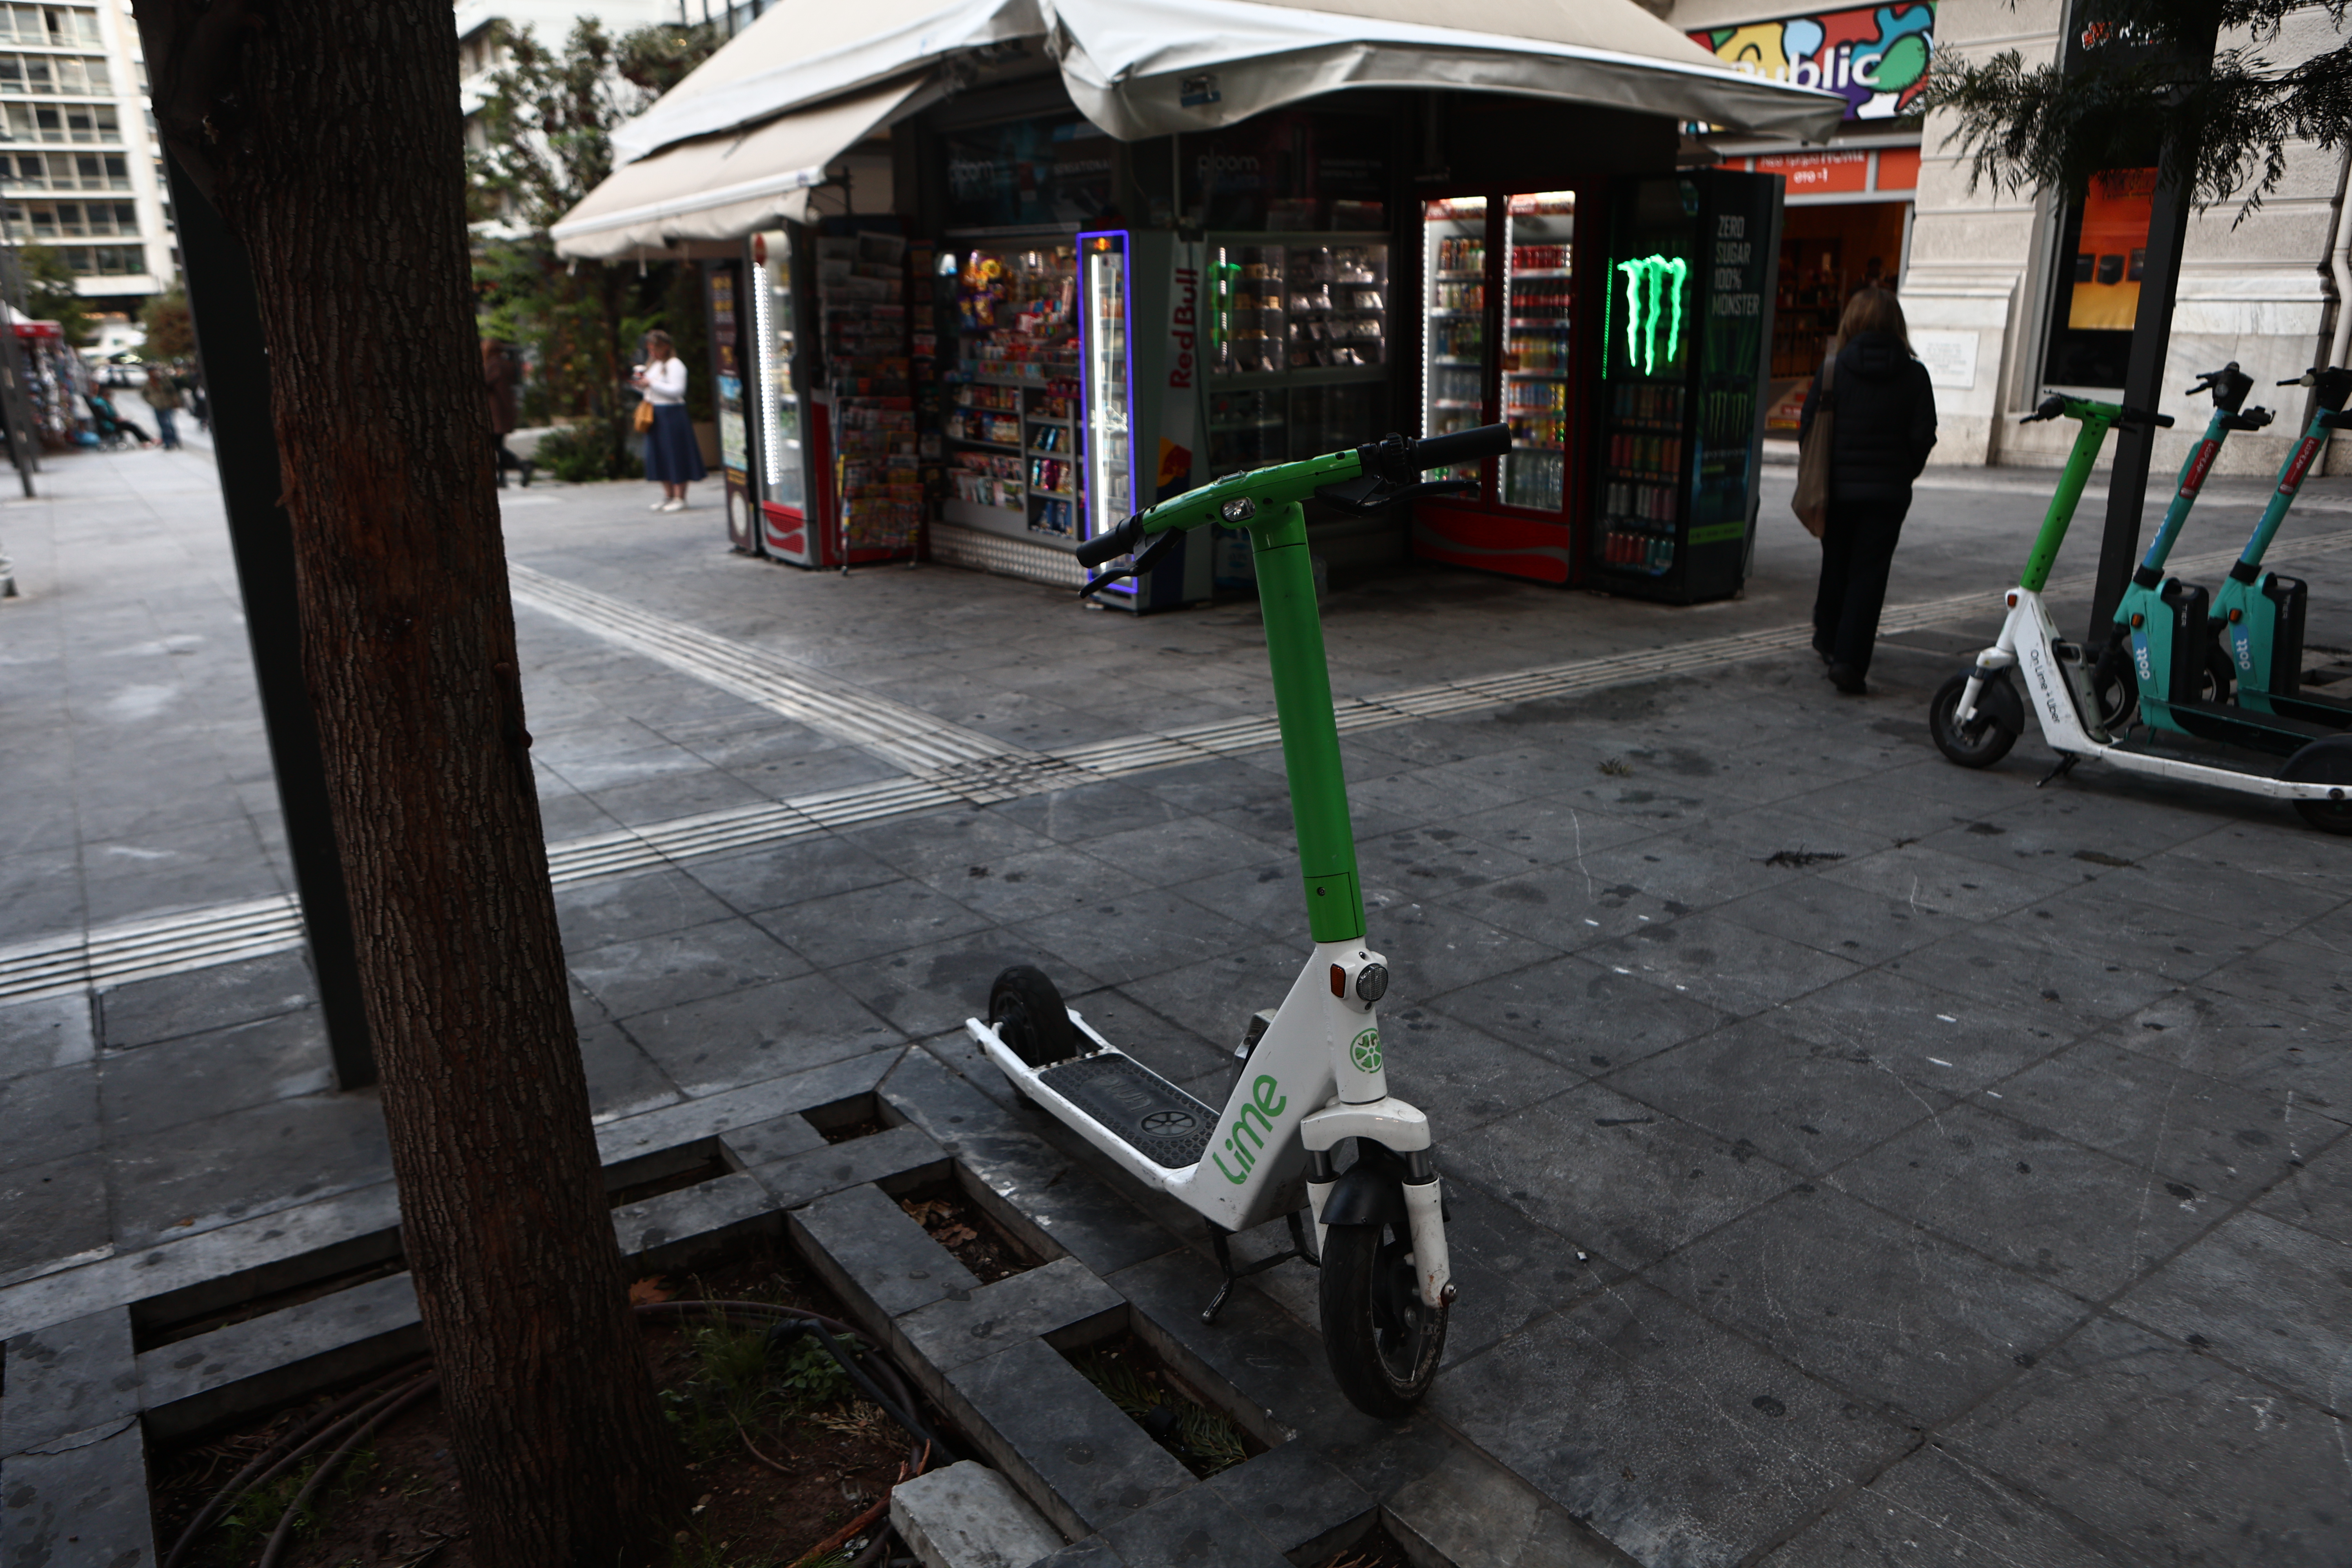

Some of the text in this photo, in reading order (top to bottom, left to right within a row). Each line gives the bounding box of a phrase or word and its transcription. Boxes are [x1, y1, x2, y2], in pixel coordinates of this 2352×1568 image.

[1717, 214, 1744, 240] ZERO
[1715, 241, 1751, 265] SUGAR
[1714, 267, 1742, 292] 100%
[1711, 293, 1760, 317] MONSTER
[1170, 268, 1198, 387] Red Bull
[2136, 647, 2150, 680] dott
[2236, 638, 2250, 670] dott
[2031, 649, 2039, 664] On
[2035, 665, 2047, 691] Lime
[2047, 698, 2060, 723] Uber
